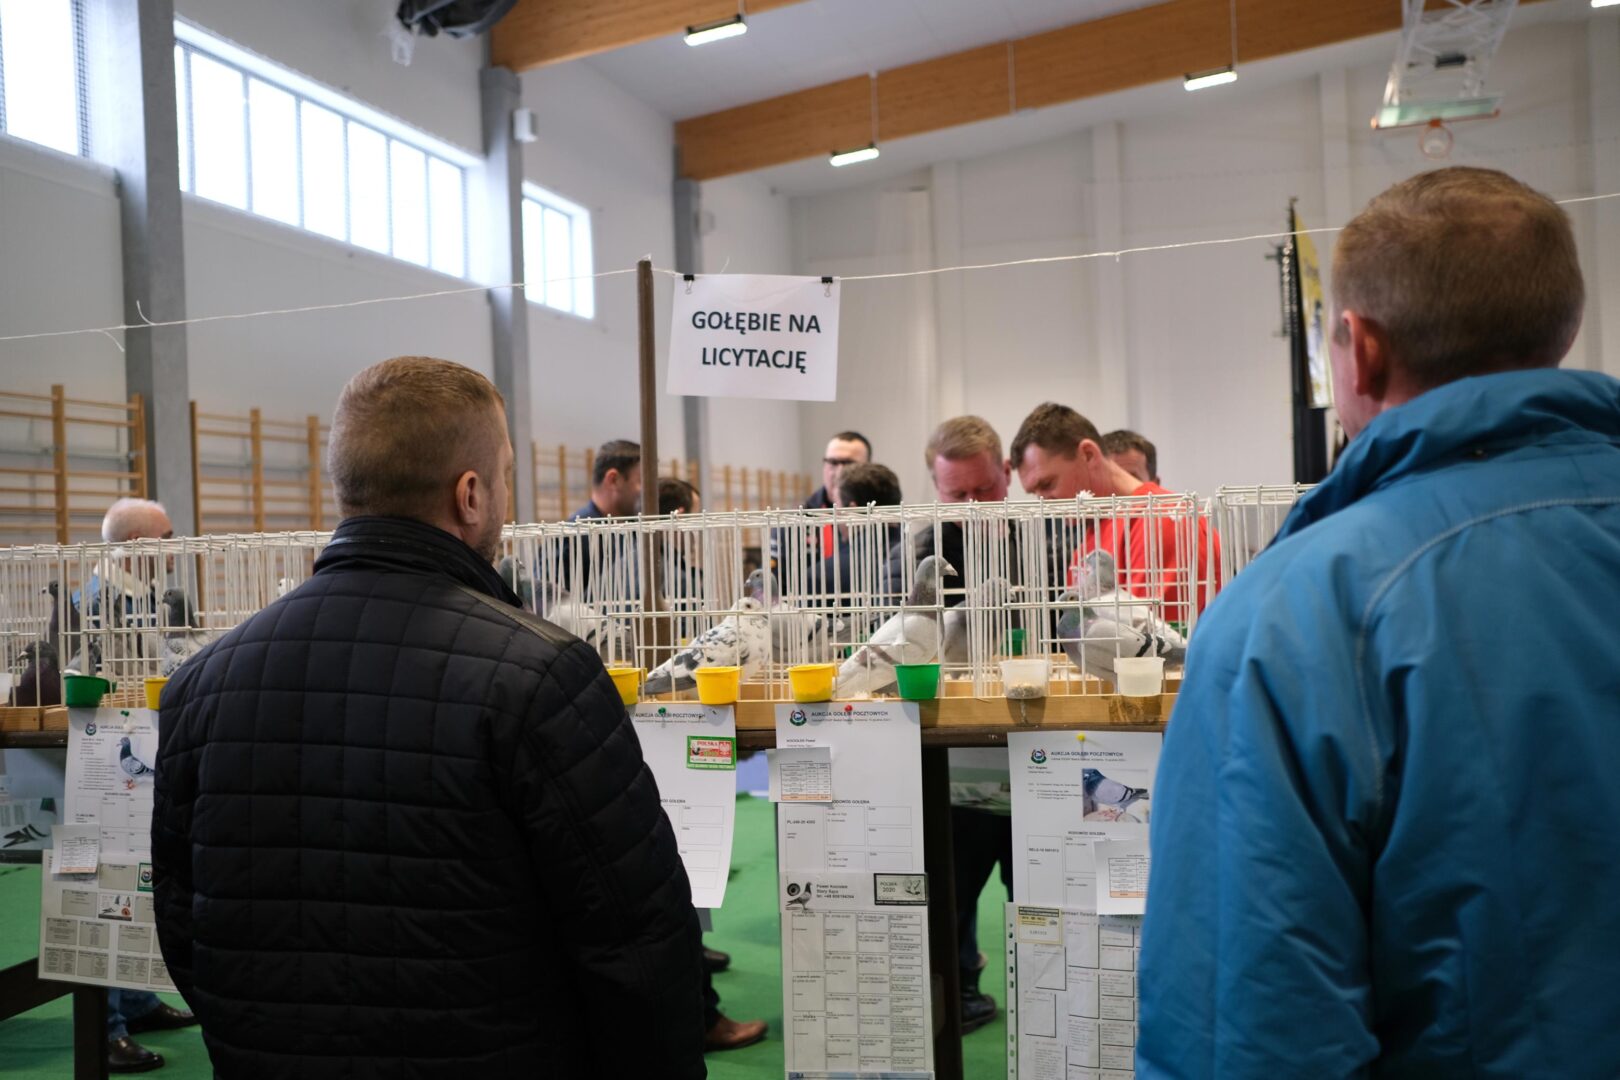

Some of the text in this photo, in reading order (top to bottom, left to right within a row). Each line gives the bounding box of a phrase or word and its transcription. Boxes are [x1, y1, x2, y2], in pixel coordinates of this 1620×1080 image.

[692, 311, 821, 335] GOŁĘBIE NA
[702, 347, 807, 374] LICYTACJĘ
